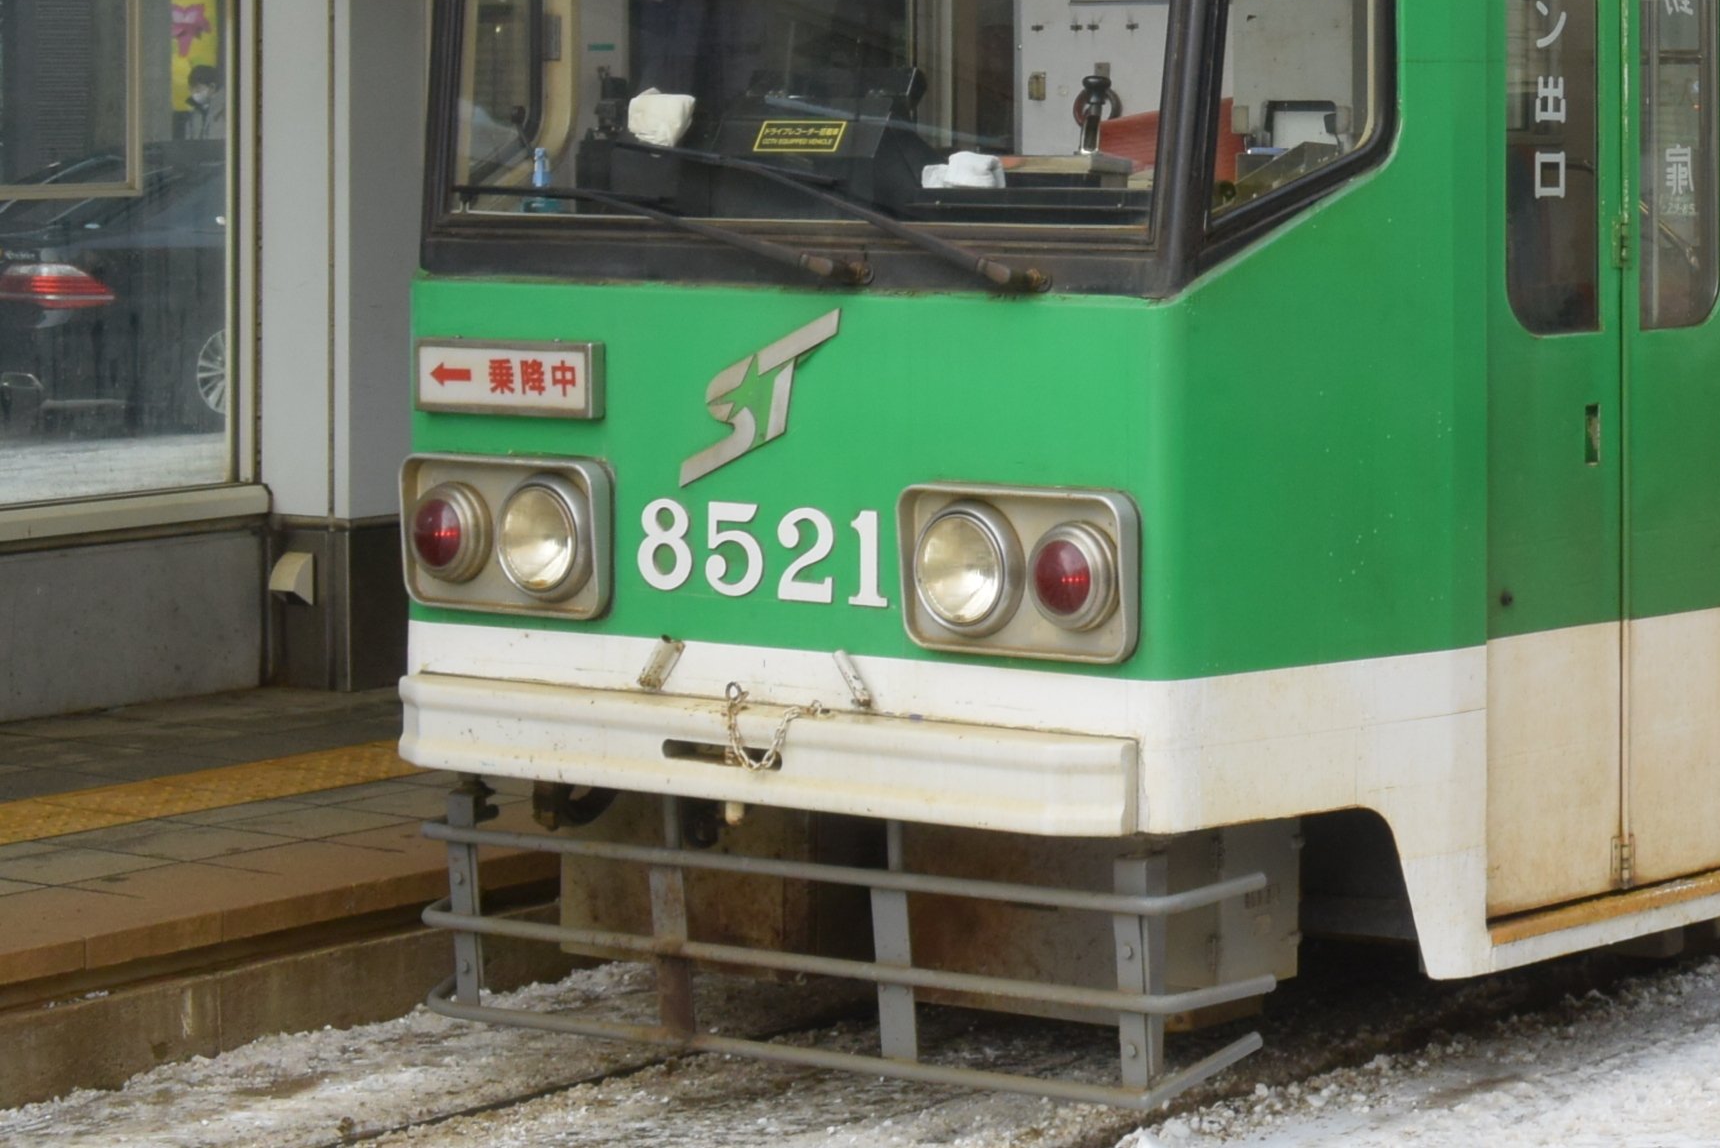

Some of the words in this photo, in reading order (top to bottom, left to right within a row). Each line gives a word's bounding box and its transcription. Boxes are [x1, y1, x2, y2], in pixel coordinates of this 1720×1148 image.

[487, 357, 578, 398] 乗降中
[636, 497, 889, 609] 8521
